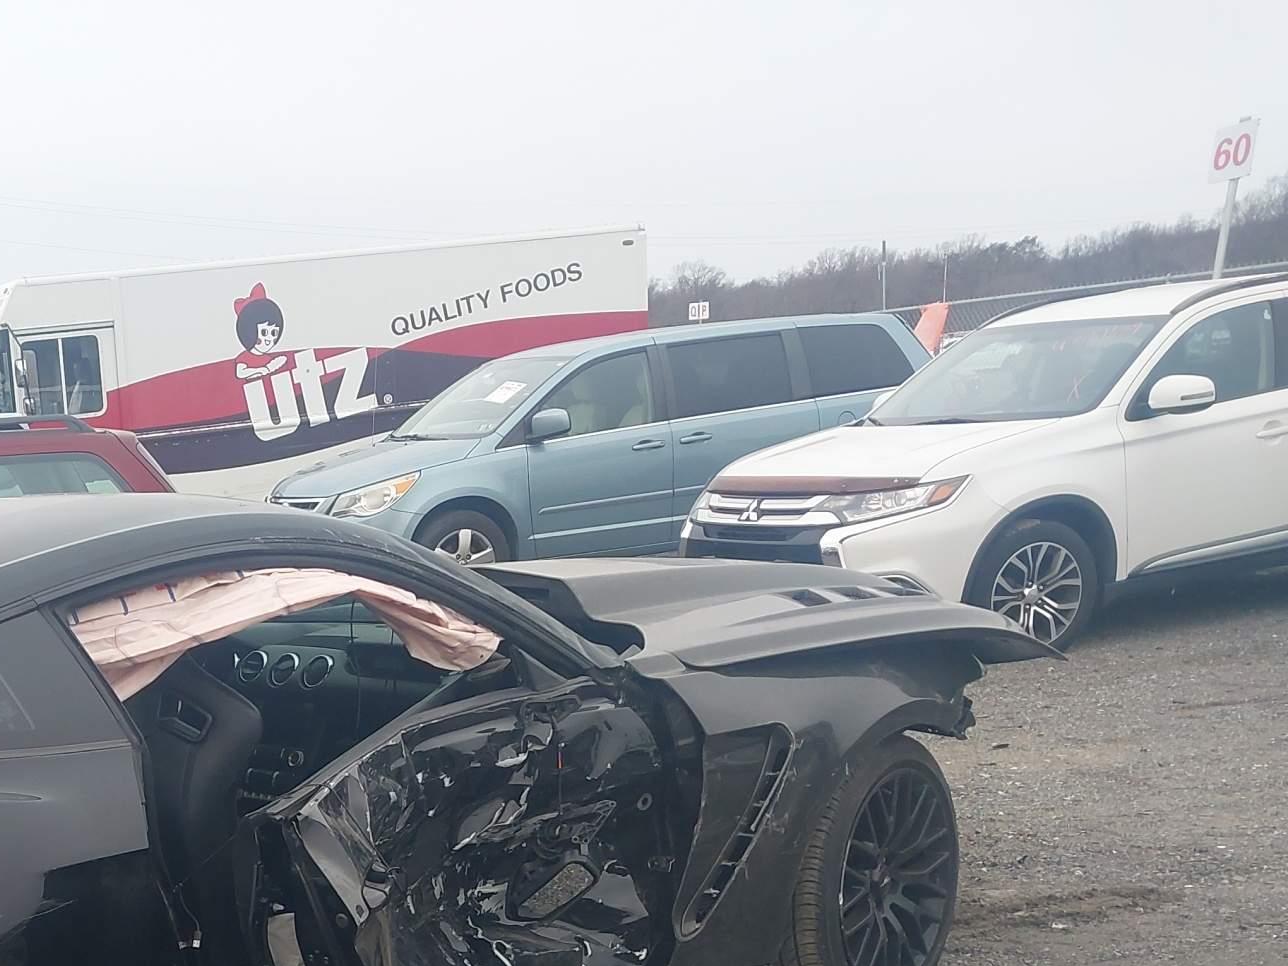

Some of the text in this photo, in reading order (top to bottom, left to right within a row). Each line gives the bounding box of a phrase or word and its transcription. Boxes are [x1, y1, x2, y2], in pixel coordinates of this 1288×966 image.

[1213, 132, 1252, 171] 60
[390, 262, 583, 336] QUALITY FOODS
